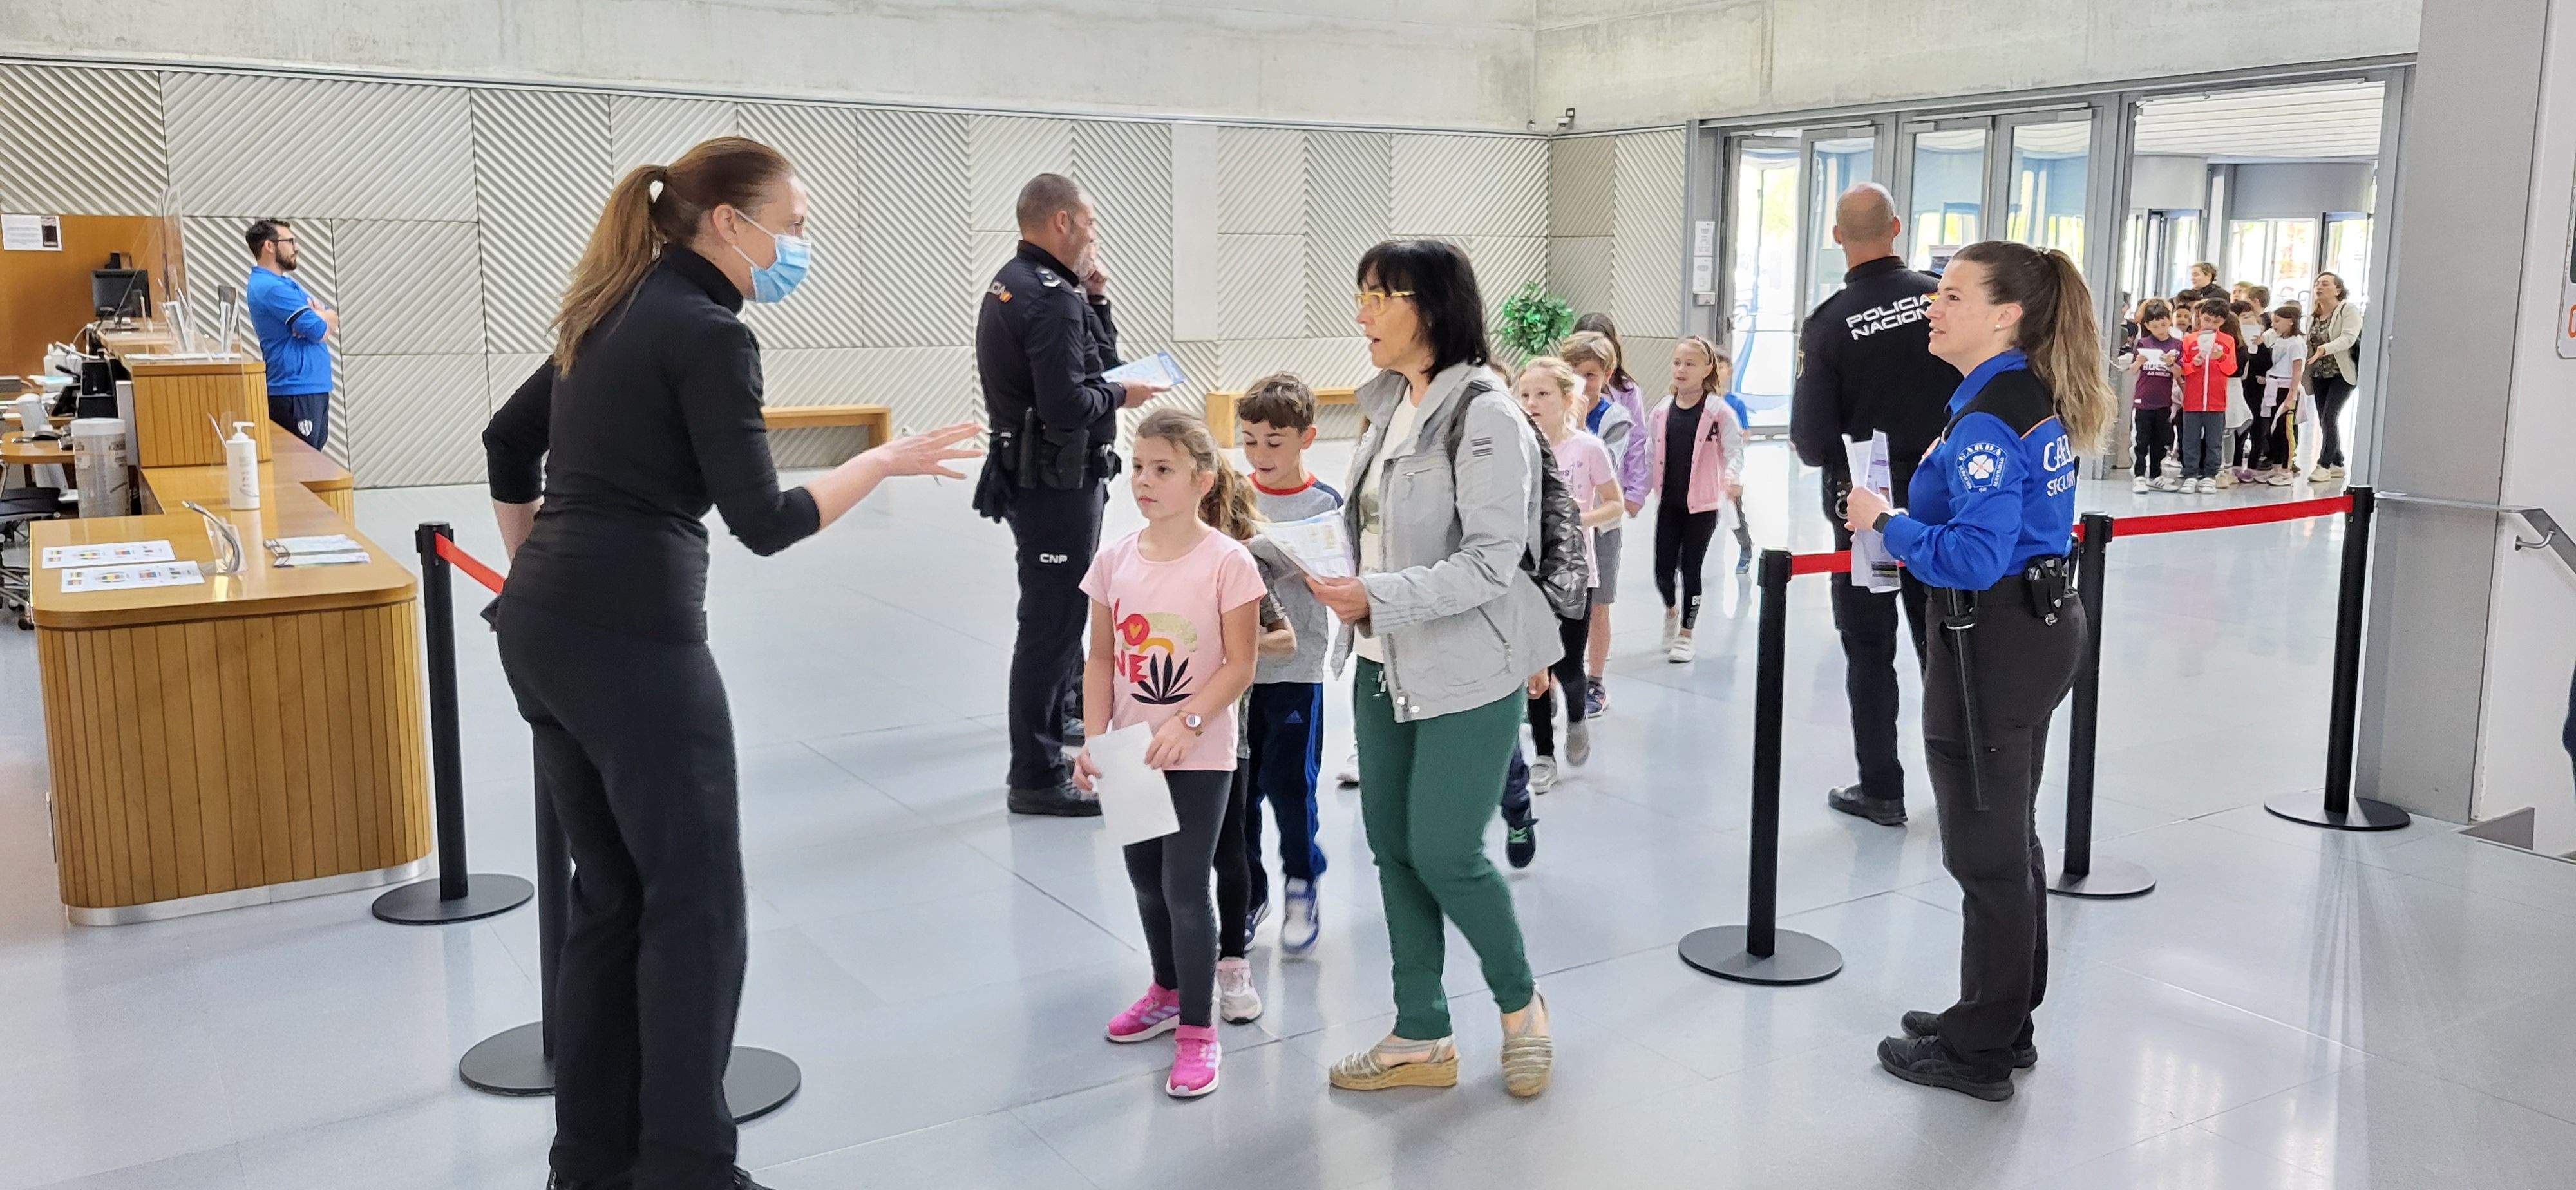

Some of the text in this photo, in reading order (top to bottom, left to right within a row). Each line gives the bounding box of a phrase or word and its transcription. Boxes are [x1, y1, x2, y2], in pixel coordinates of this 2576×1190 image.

[1846, 294, 1933, 328] POLICIA
[1705, 421, 1721, 442] A
[1039, 553, 1068, 563] CNP
